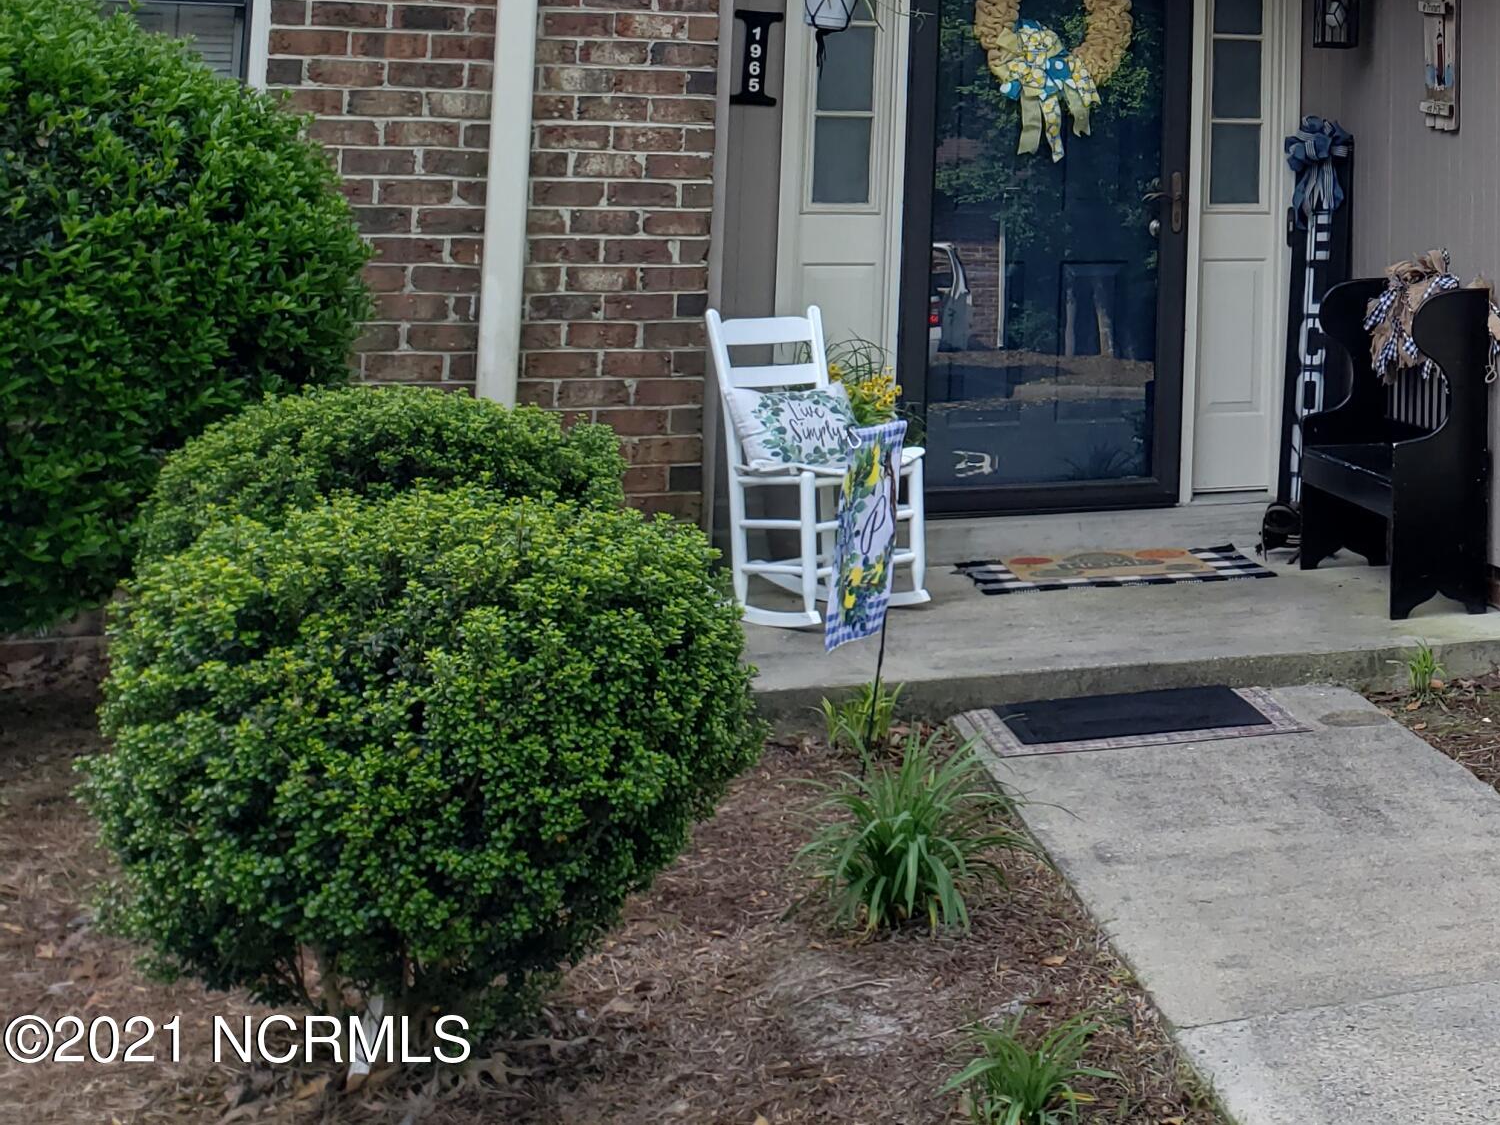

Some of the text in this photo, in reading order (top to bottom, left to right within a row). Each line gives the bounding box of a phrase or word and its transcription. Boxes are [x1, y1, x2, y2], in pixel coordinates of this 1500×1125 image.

[748, 26, 762, 93] 1965
[784, 396, 825, 421] Live
[789, 419, 843, 448] Simply
